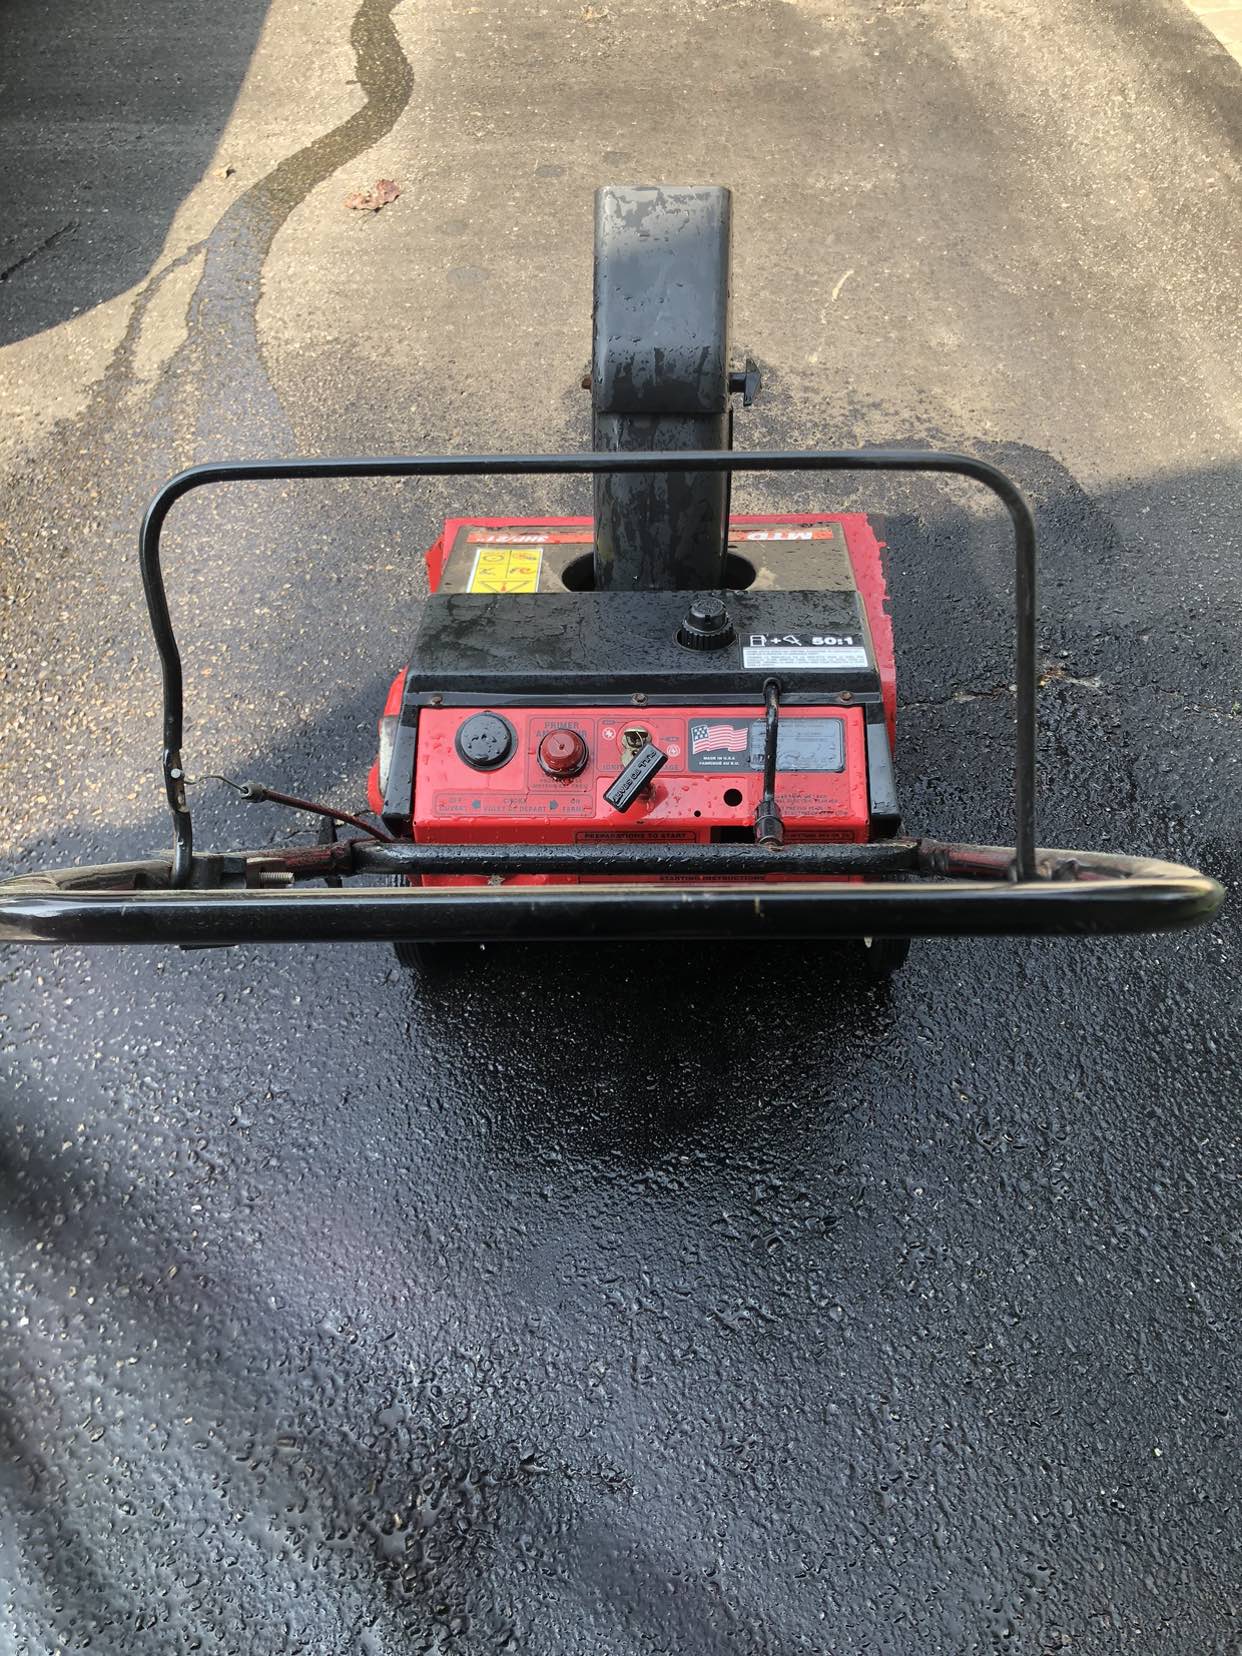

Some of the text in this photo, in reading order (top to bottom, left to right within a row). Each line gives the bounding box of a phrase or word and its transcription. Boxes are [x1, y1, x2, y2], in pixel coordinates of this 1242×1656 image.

[746, 531, 813, 541] MTD
[811, 636, 854, 646] 50:1
[543, 721, 580, 730] PRIMER
[584, 832, 644, 840] PREPARATIONS
[661, 832, 687, 840] START
